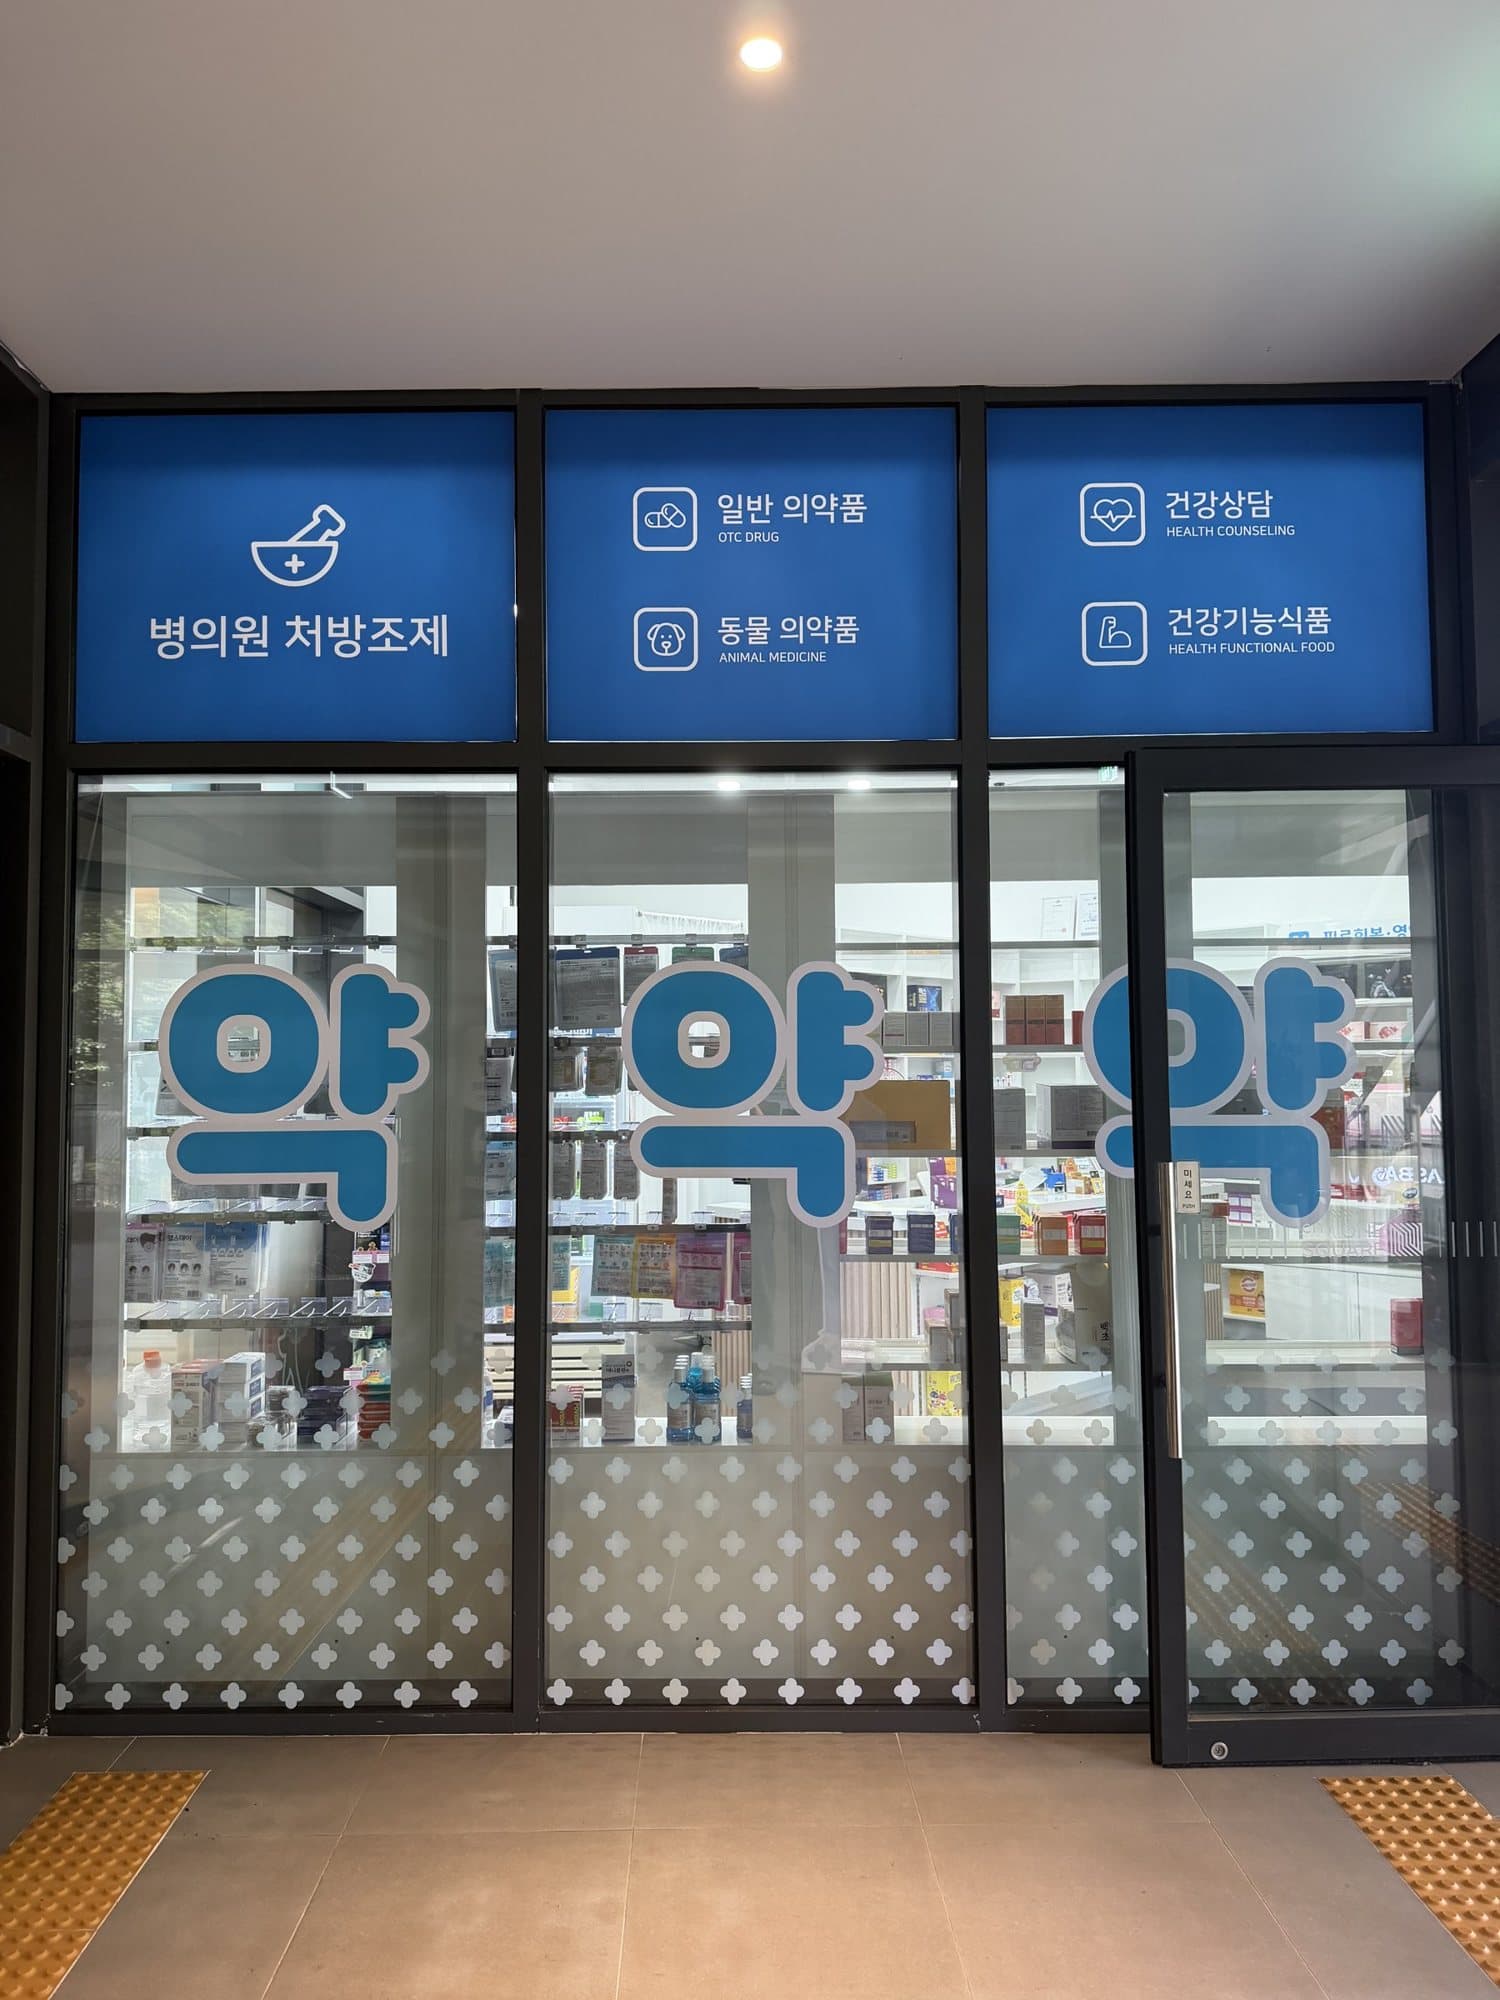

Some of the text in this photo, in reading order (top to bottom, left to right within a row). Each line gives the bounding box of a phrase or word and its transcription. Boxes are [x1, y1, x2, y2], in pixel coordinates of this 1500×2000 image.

[718, 494, 867, 524] 일반 의약품
[1166, 490, 1273, 519] 건강상담
[719, 532, 779, 542] OTC DRUG
[1167, 526, 1294, 536] HEALTH COUNSELING
[718, 616, 859, 645] 동물 의약품
[1169, 606, 1331, 636] 건강기능식품
[151, 615, 447, 659] 병의원 처방조제
[1170, 642, 1334, 654] HEALTH FUNCTIONAL FOOD
[720, 652, 826, 662] ANIMAL MEDICINE
[158, 963, 430, 1232] 약
[622, 961, 884, 1228] 약
[1082, 957, 1356, 1228] 약
[1183, 1169, 1193, 1199] 미세요
